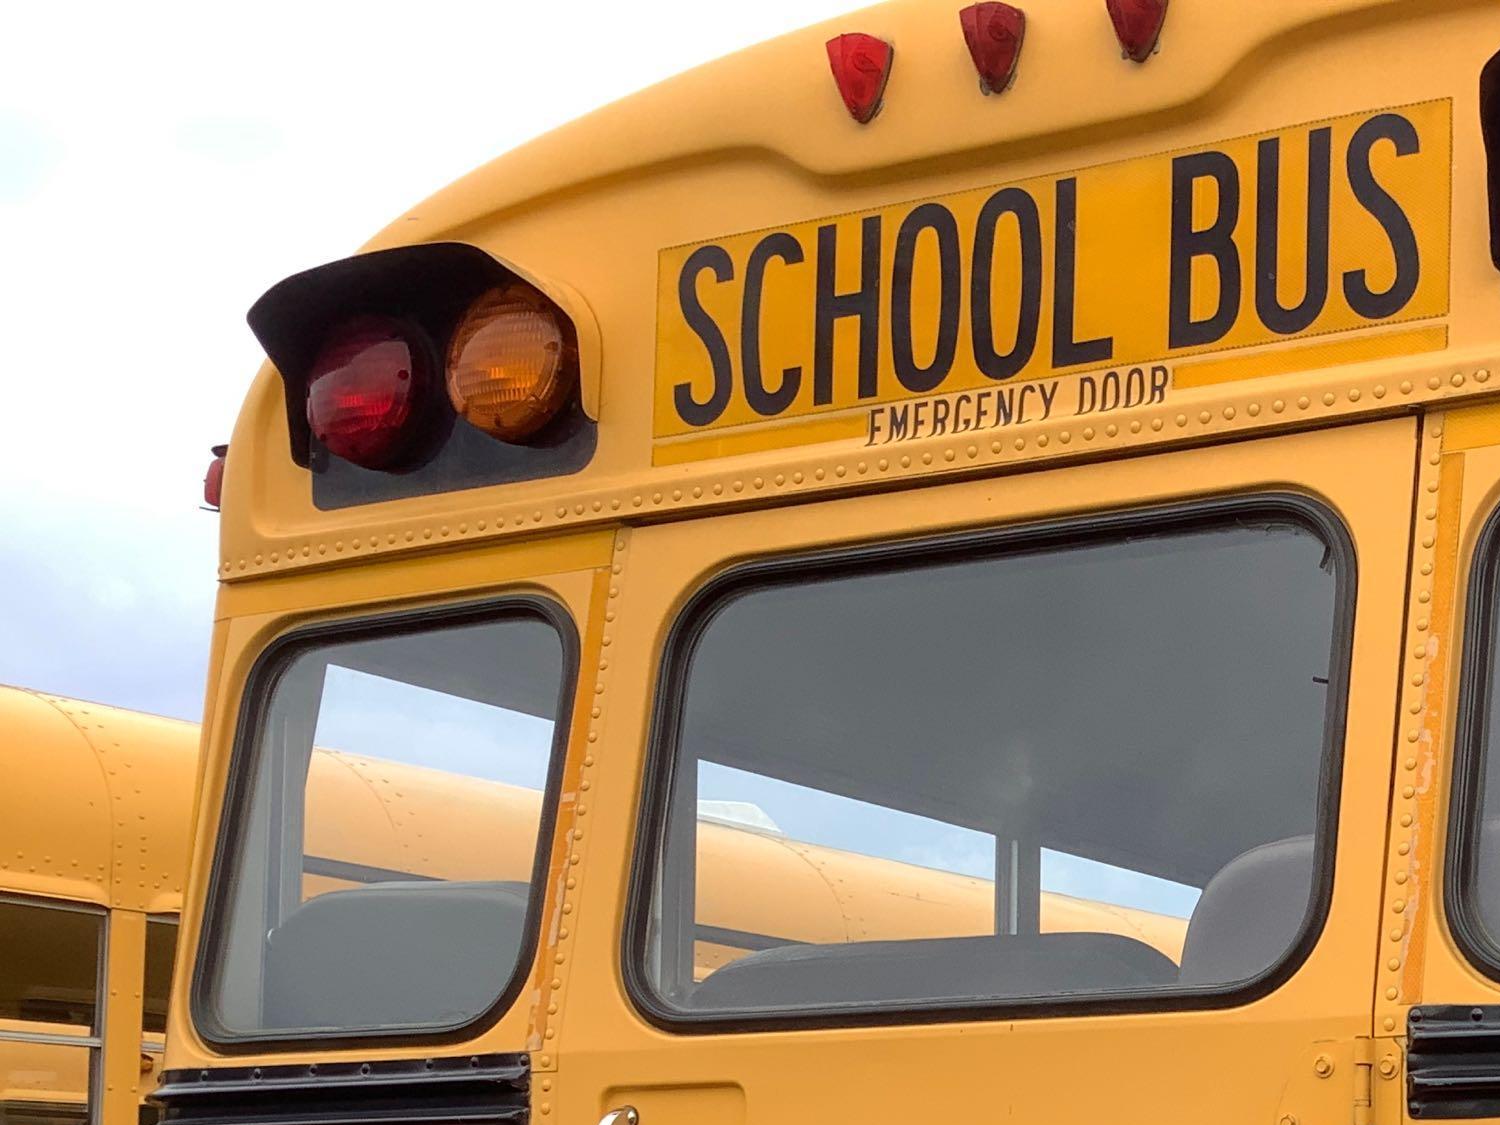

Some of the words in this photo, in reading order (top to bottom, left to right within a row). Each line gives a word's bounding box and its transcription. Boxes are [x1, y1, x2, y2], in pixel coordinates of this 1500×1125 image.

[673, 178, 1113, 427] SCHOOL
[1168, 113, 1421, 349] BUS
[864, 380, 1059, 447] EMERGENCY
[1073, 364, 1170, 416] DOOR
